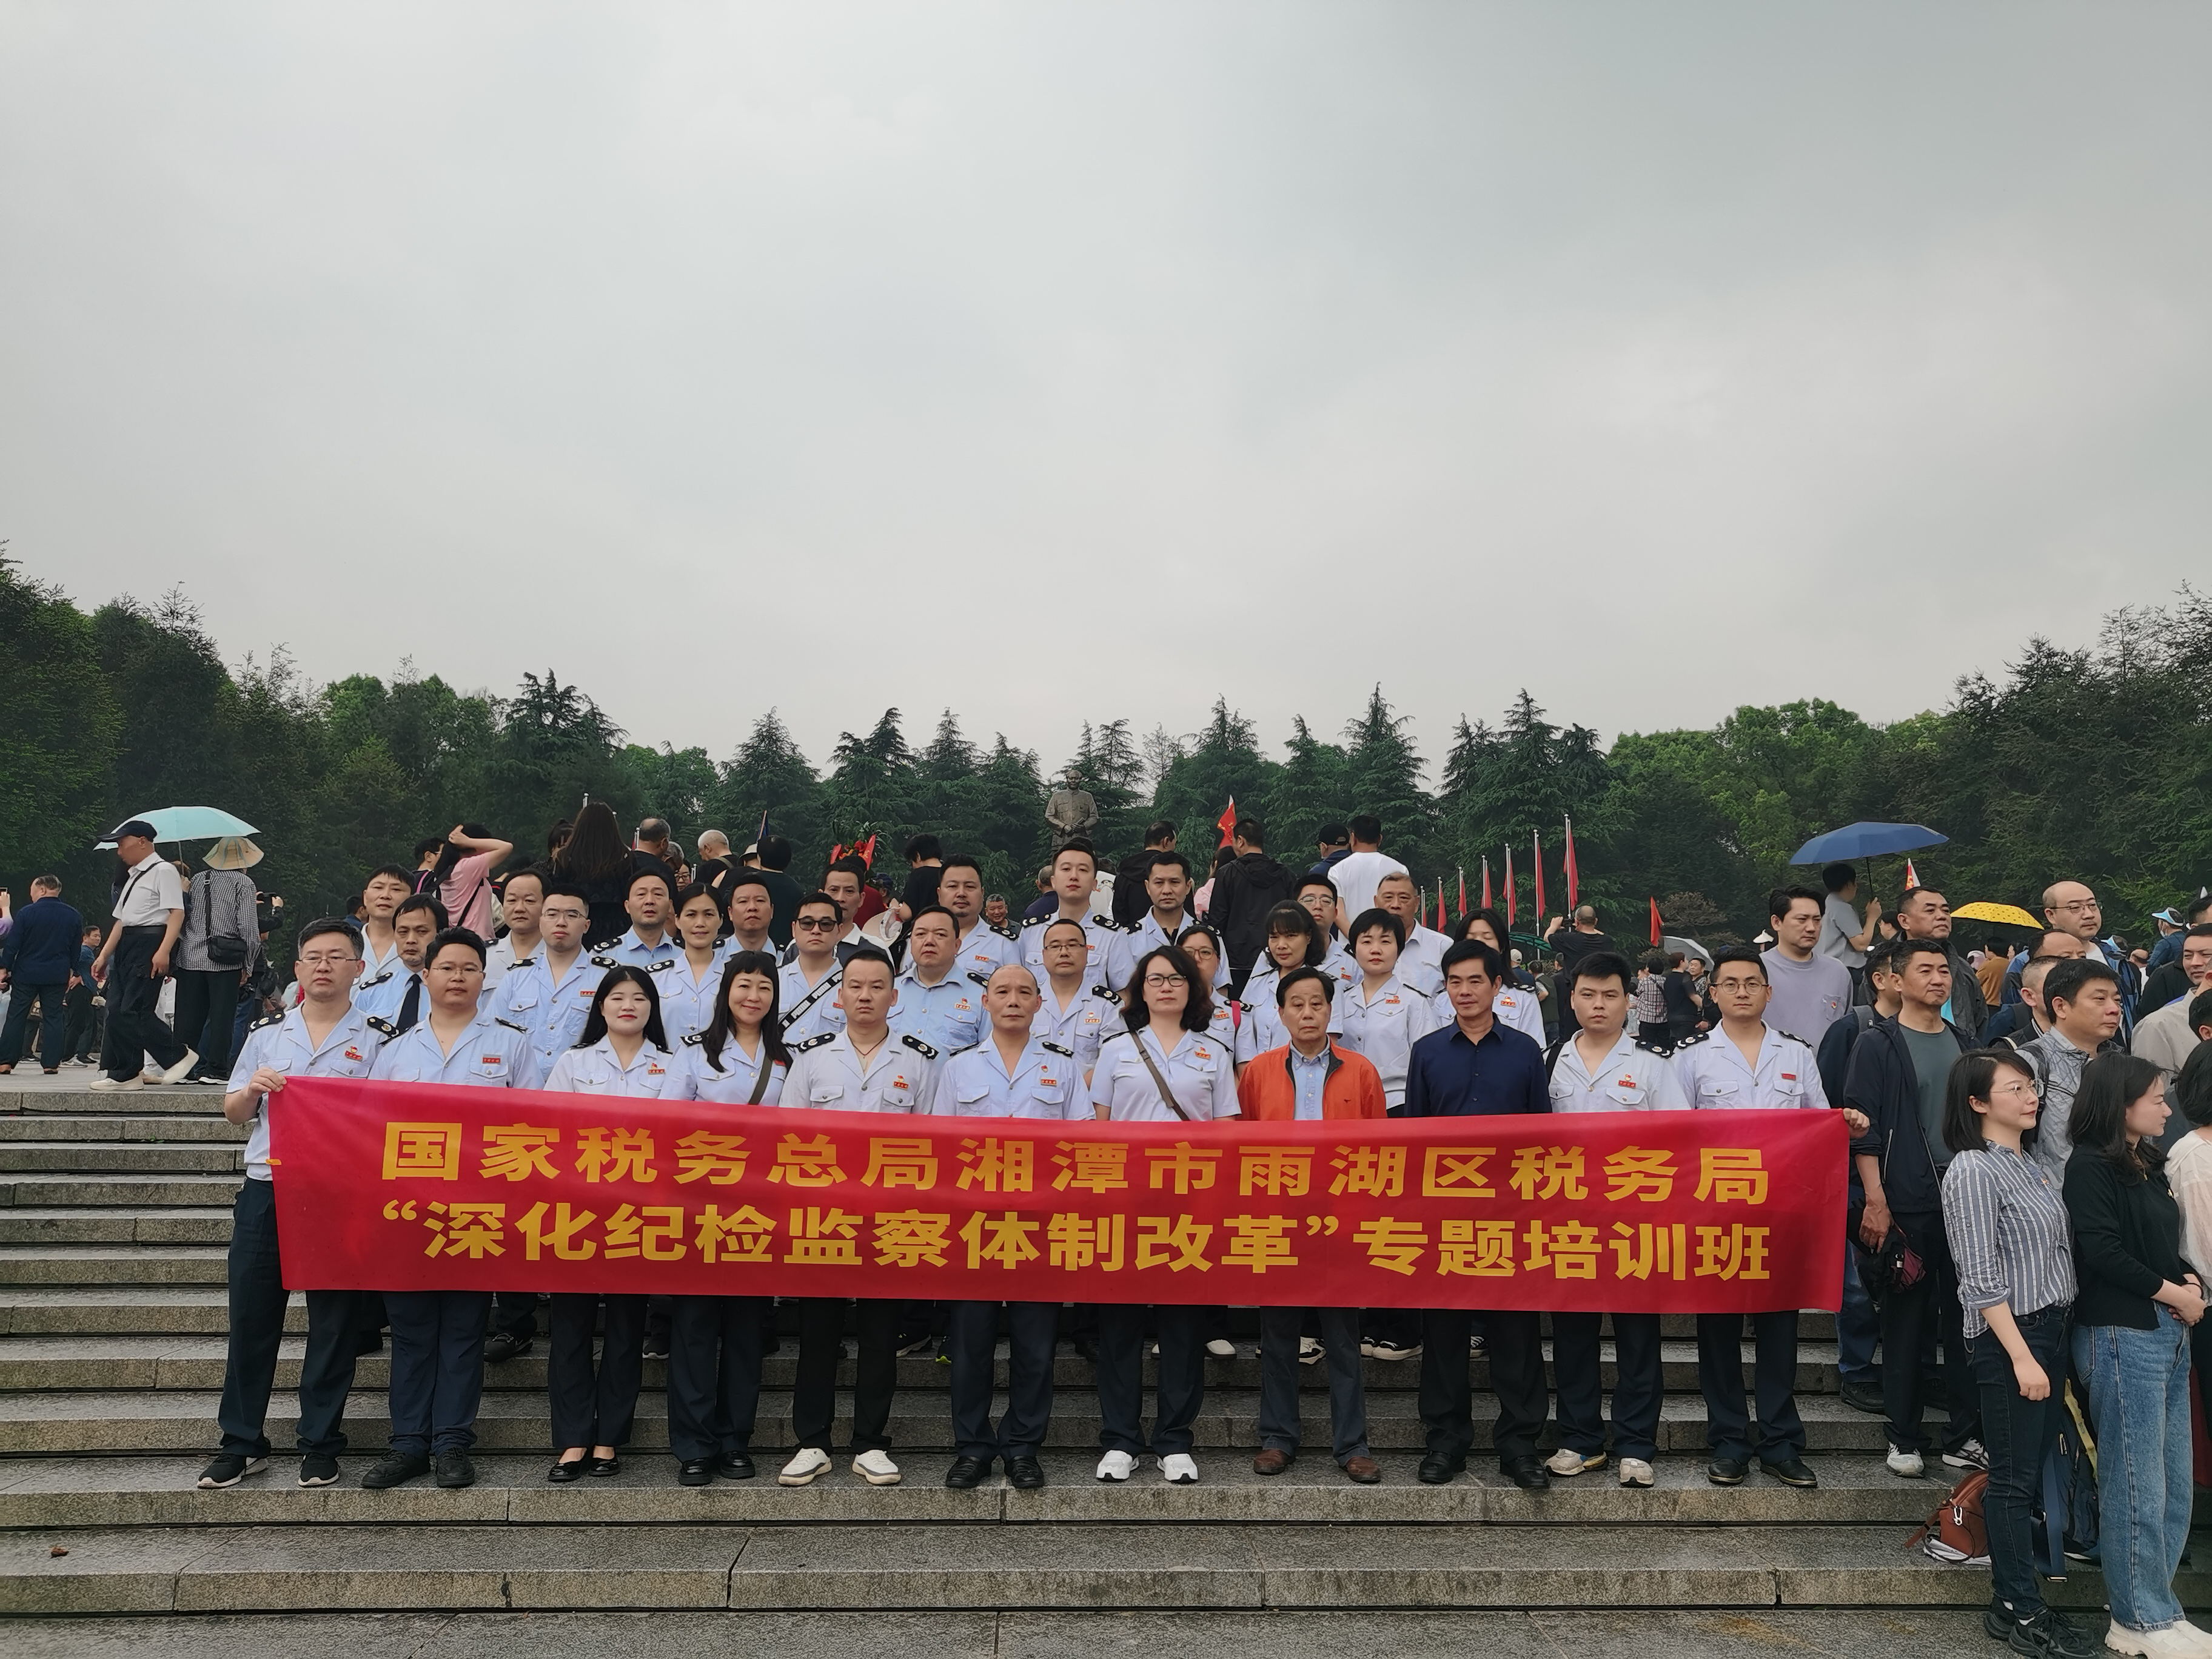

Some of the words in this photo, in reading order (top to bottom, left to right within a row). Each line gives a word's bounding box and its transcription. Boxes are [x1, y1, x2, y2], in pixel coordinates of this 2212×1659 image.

[382, 1122, 1768, 1204] 国家税务总局湘潭市雨湖区税务局
[383, 1199, 1770, 1281] “深化纪检监察体制改革”专题培训班
